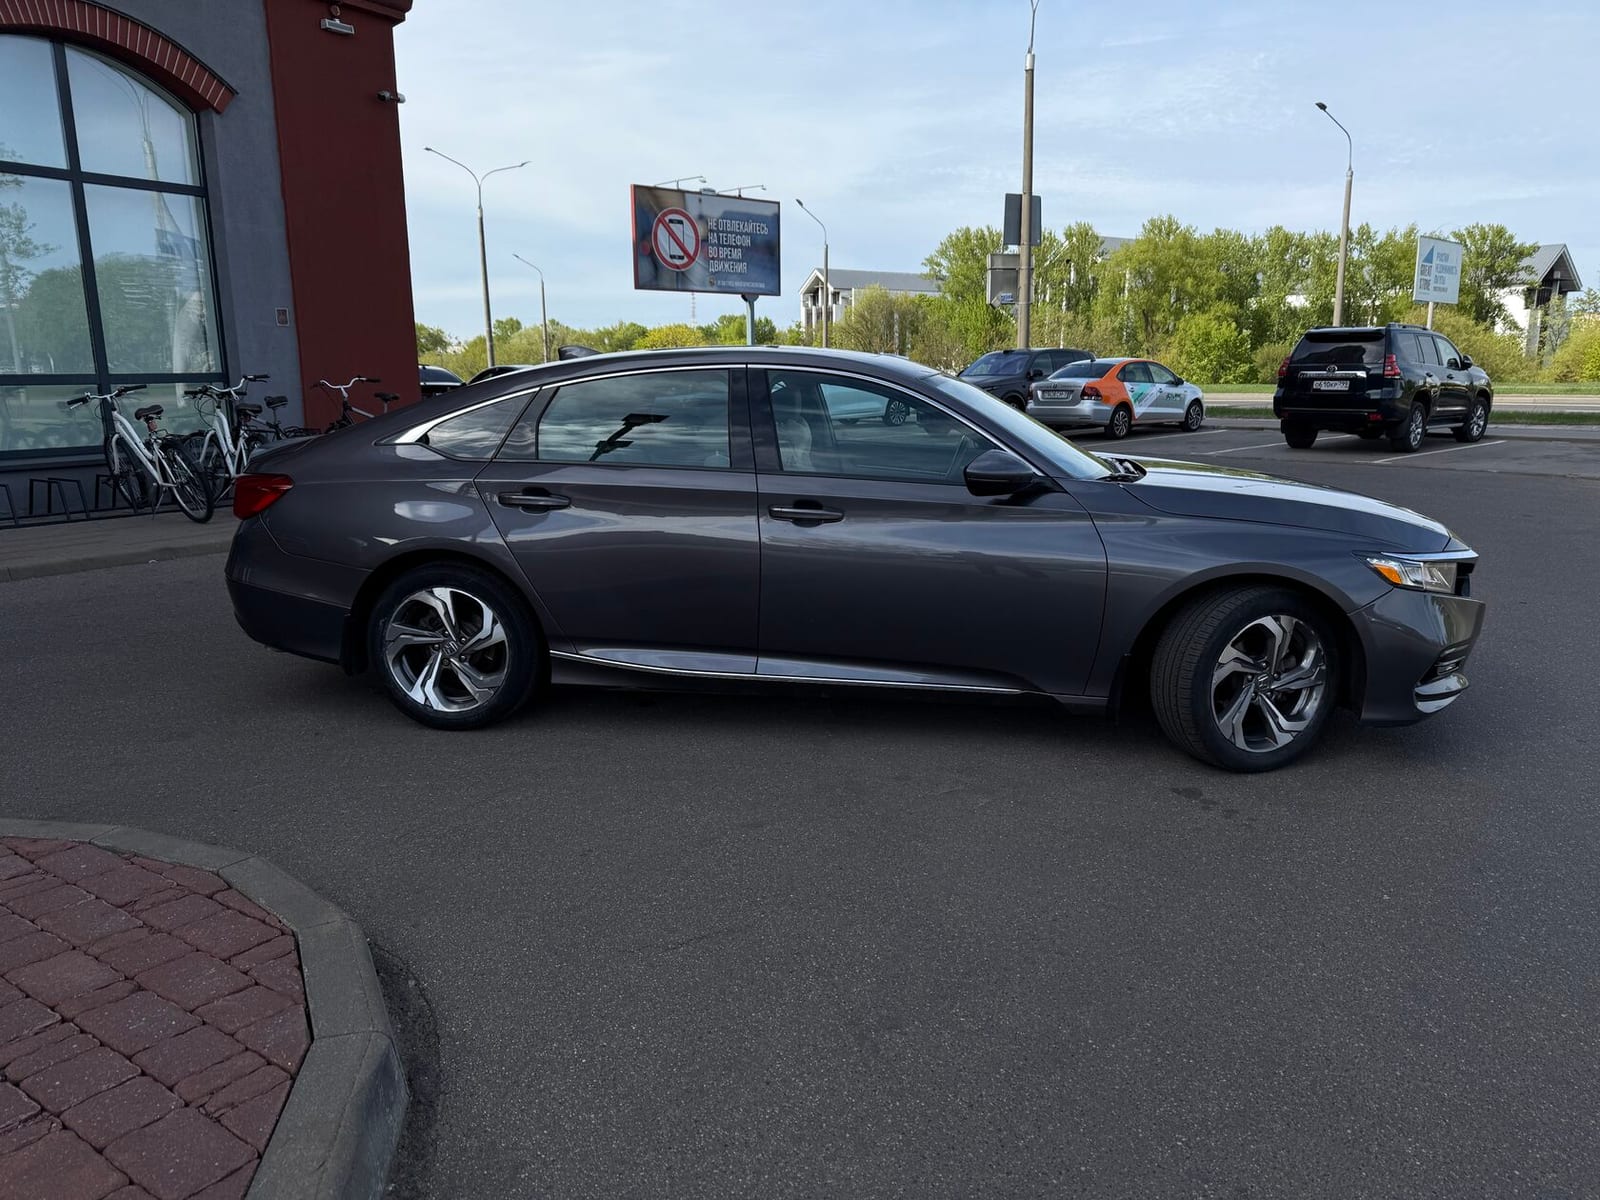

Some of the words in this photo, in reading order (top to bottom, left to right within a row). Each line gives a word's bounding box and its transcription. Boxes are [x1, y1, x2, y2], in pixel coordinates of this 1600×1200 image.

[708, 218, 717, 230] НЕ
[719, 219, 768, 234] ОТВЛЕКАЙТЕСЬ
[708, 232, 718, 244] НА
[719, 233, 751, 247] ТЕЛЕФОН
[708, 246, 718, 258] ВО
[719, 247, 742, 259] ВРЕМЯ
[709, 260, 748, 273] ДВИЖЕНИЯ
